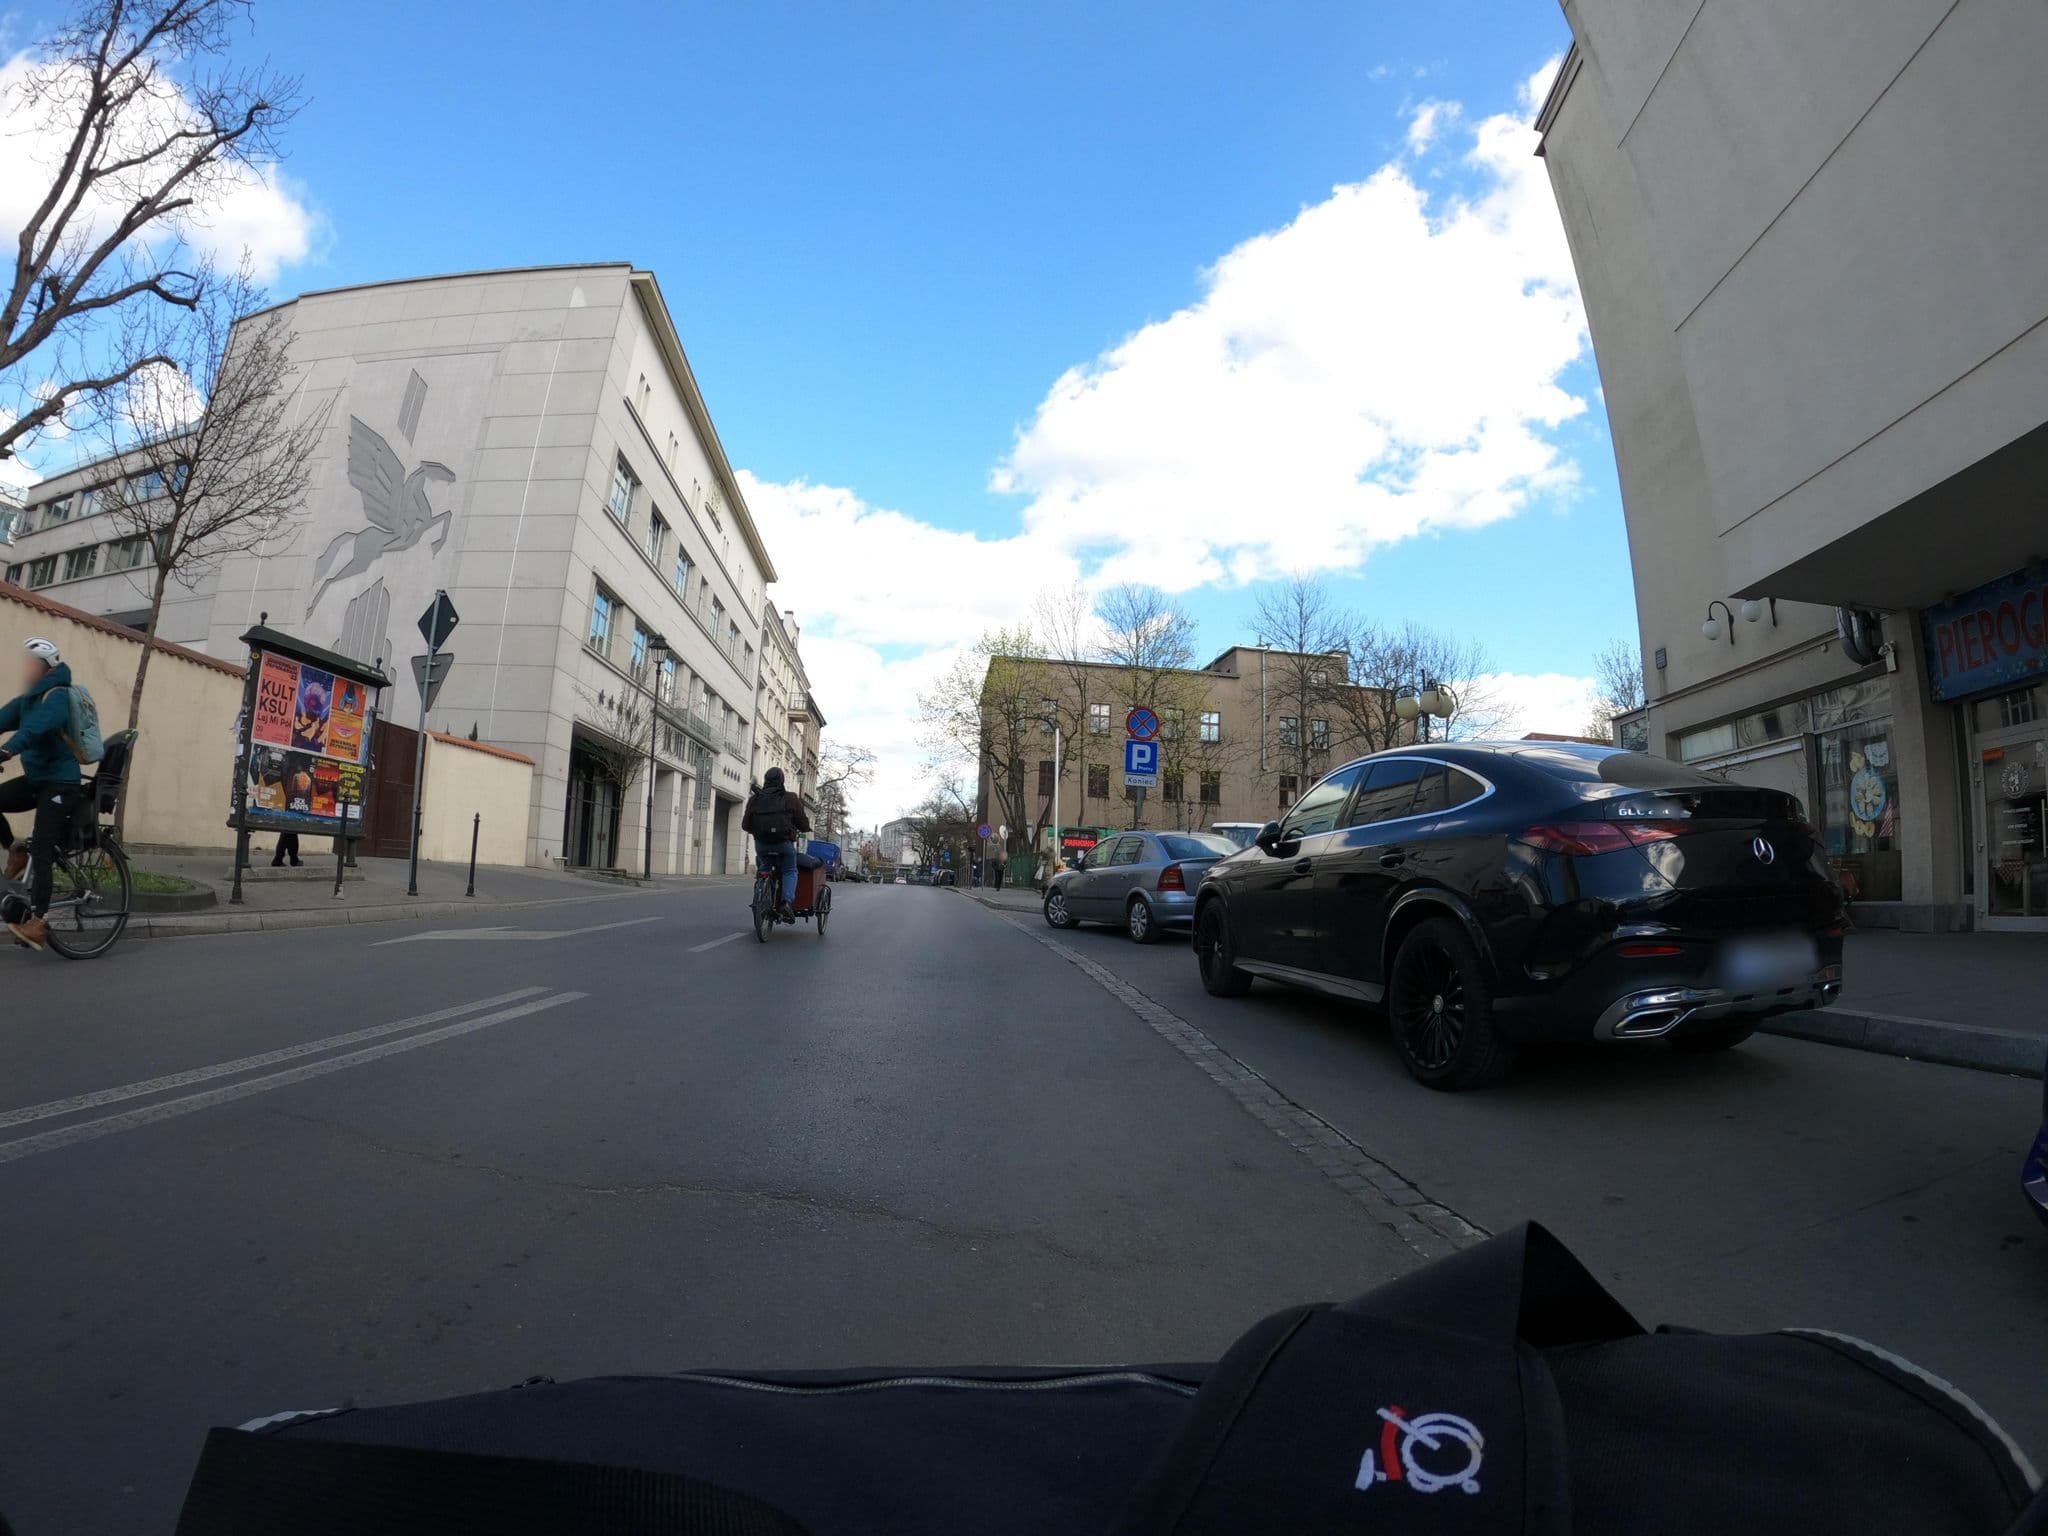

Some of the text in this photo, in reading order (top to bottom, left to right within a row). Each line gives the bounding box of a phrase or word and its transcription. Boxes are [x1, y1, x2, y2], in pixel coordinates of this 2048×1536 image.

[1936, 583, 2048, 678] PIEROG
[261, 679, 296, 701] KULT
[259, 696, 288, 716] KSU
[1131, 743, 1152, 770] P
[1127, 776, 1153, 785] Koniec
